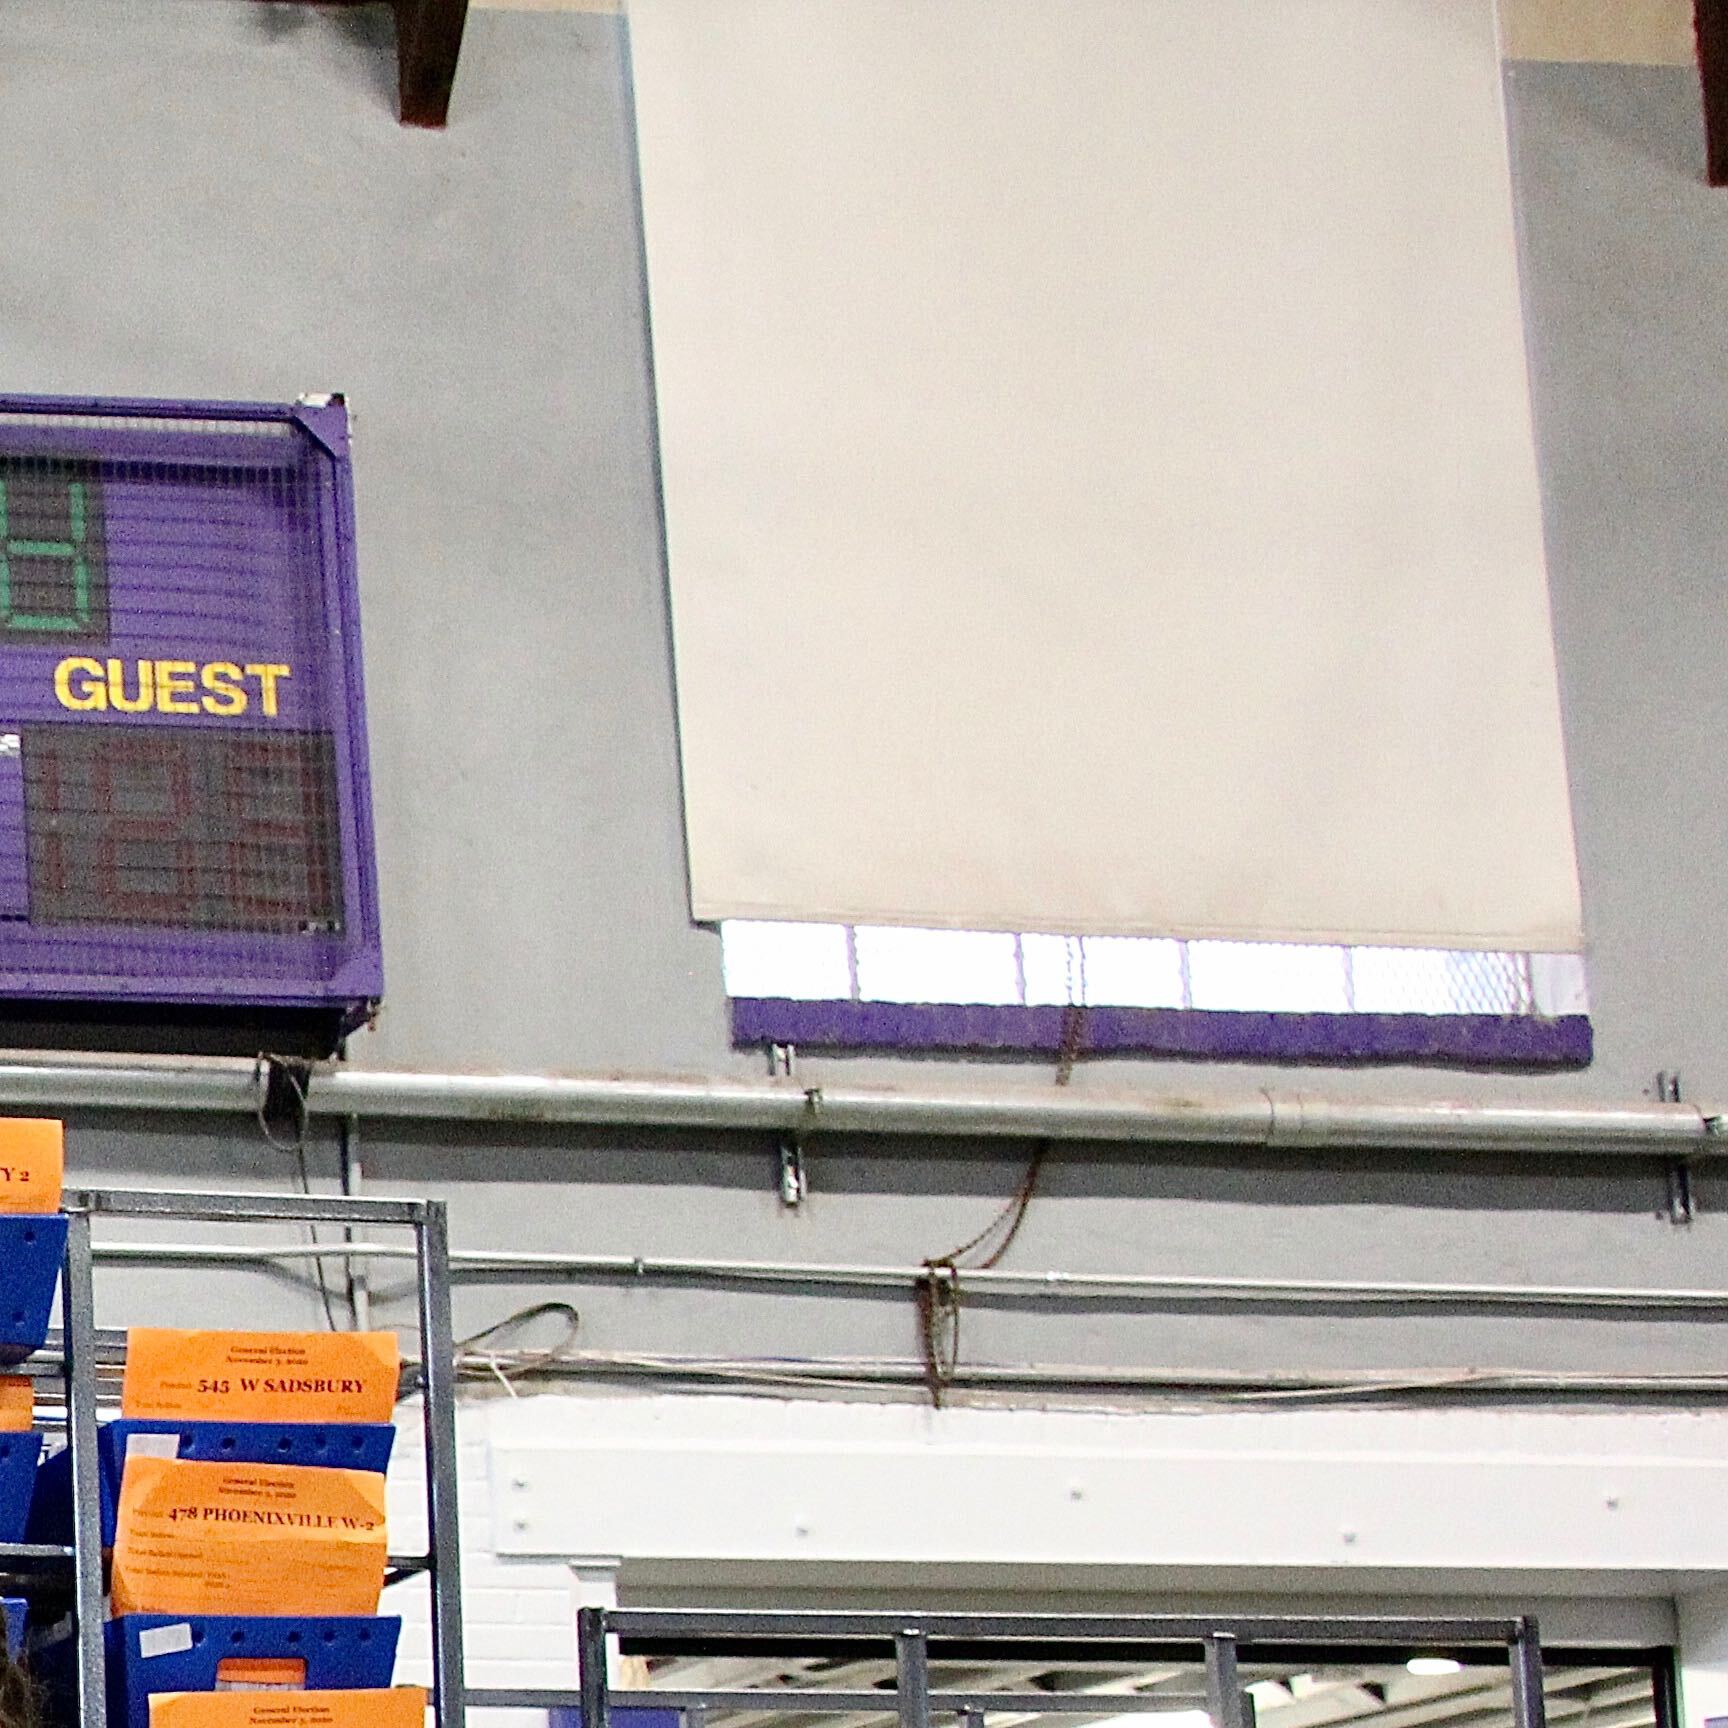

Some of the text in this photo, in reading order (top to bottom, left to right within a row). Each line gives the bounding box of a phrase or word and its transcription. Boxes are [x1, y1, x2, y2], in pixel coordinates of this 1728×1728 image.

[54, 657, 291, 717] GUEST
[20, 1171, 29, 1181] 2
[198, 1378, 365, 1393] 545 W SADSBURY
[168, 1508, 197, 1522] 478
[203, 1508, 338, 1527] PHOENIXVILLE
[341, 1517, 374, 1530] W-2
[253, 1706, 290, 1714] General
